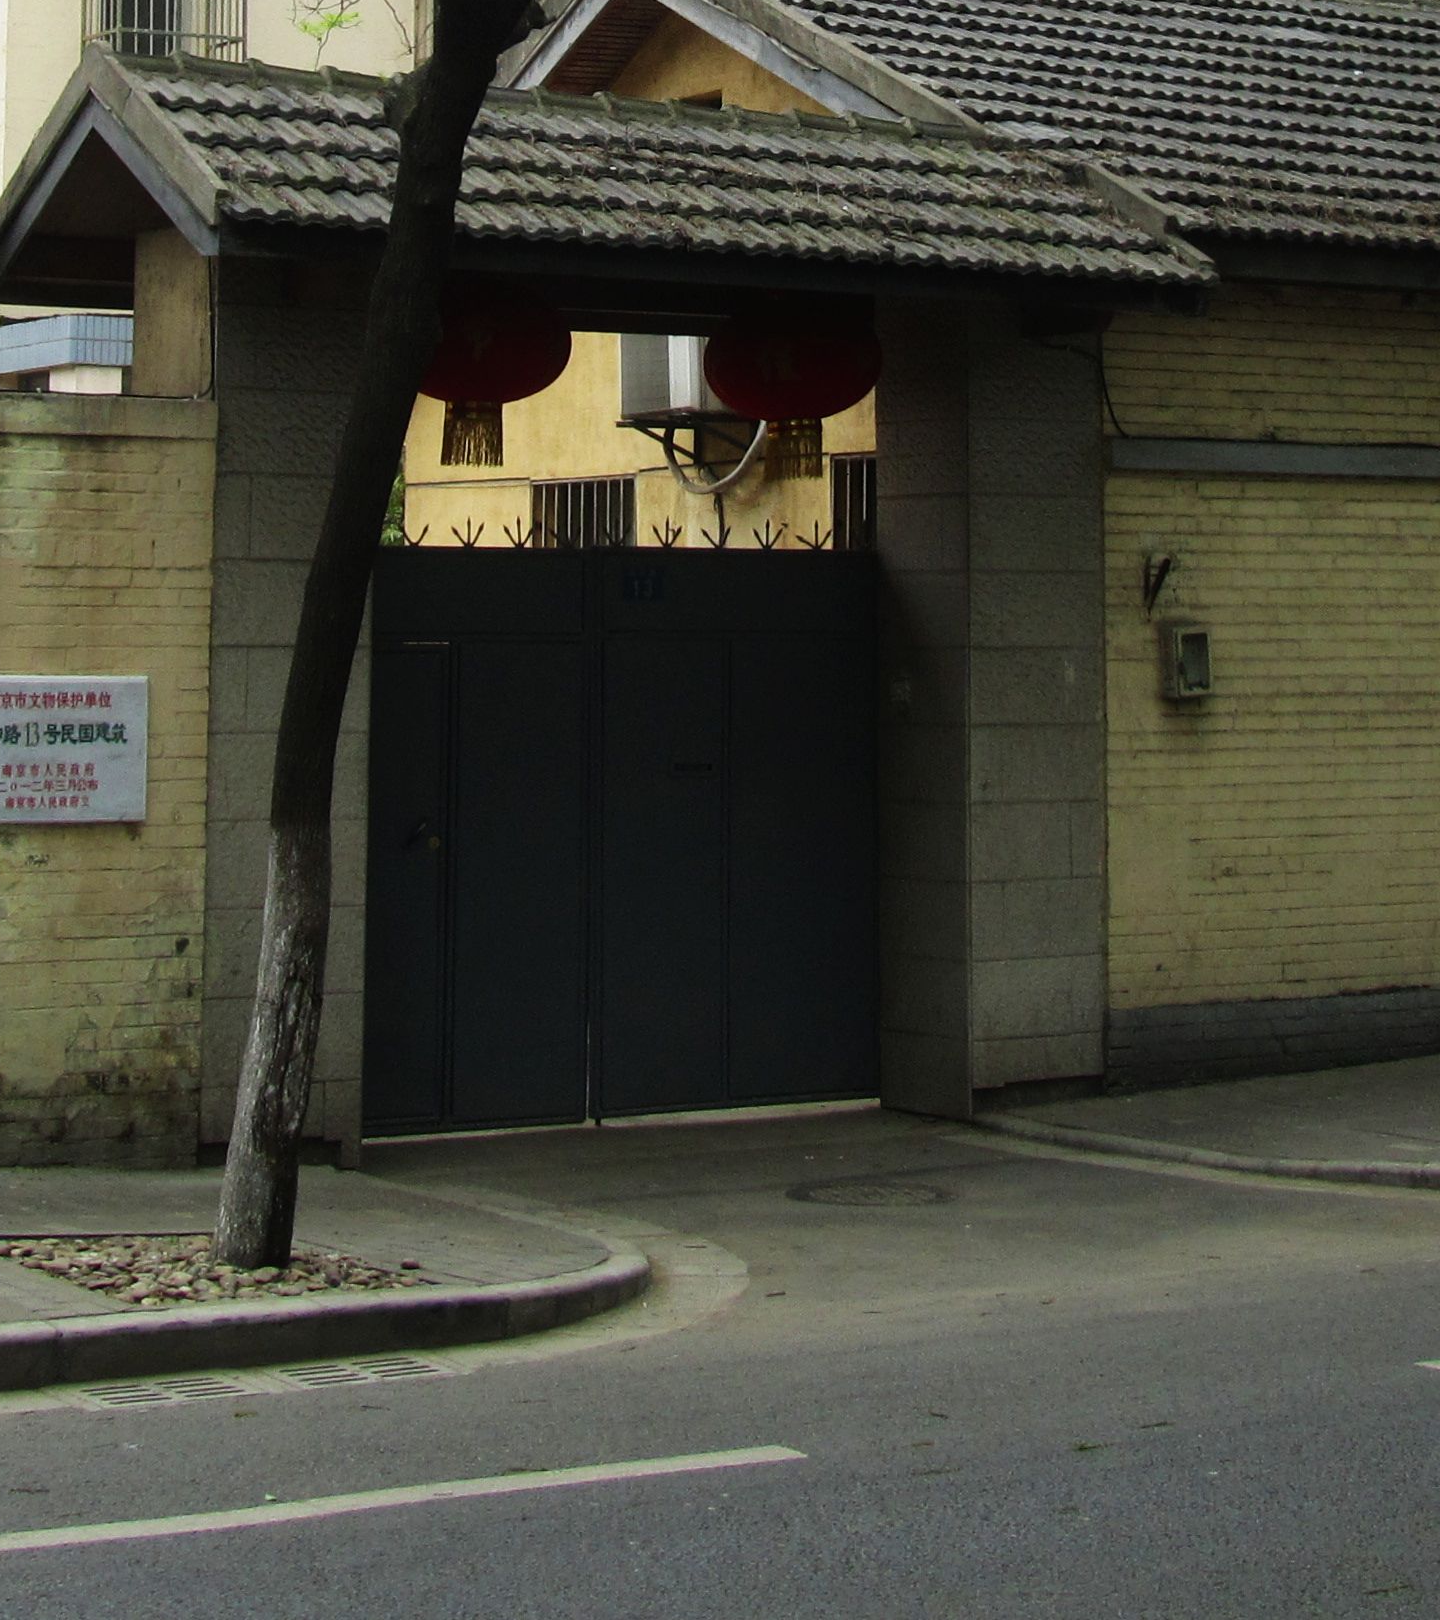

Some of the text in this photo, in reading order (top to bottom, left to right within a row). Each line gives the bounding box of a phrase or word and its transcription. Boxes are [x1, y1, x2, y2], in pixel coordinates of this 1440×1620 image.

[1, 762, 96, 778] 南京市人民政府
